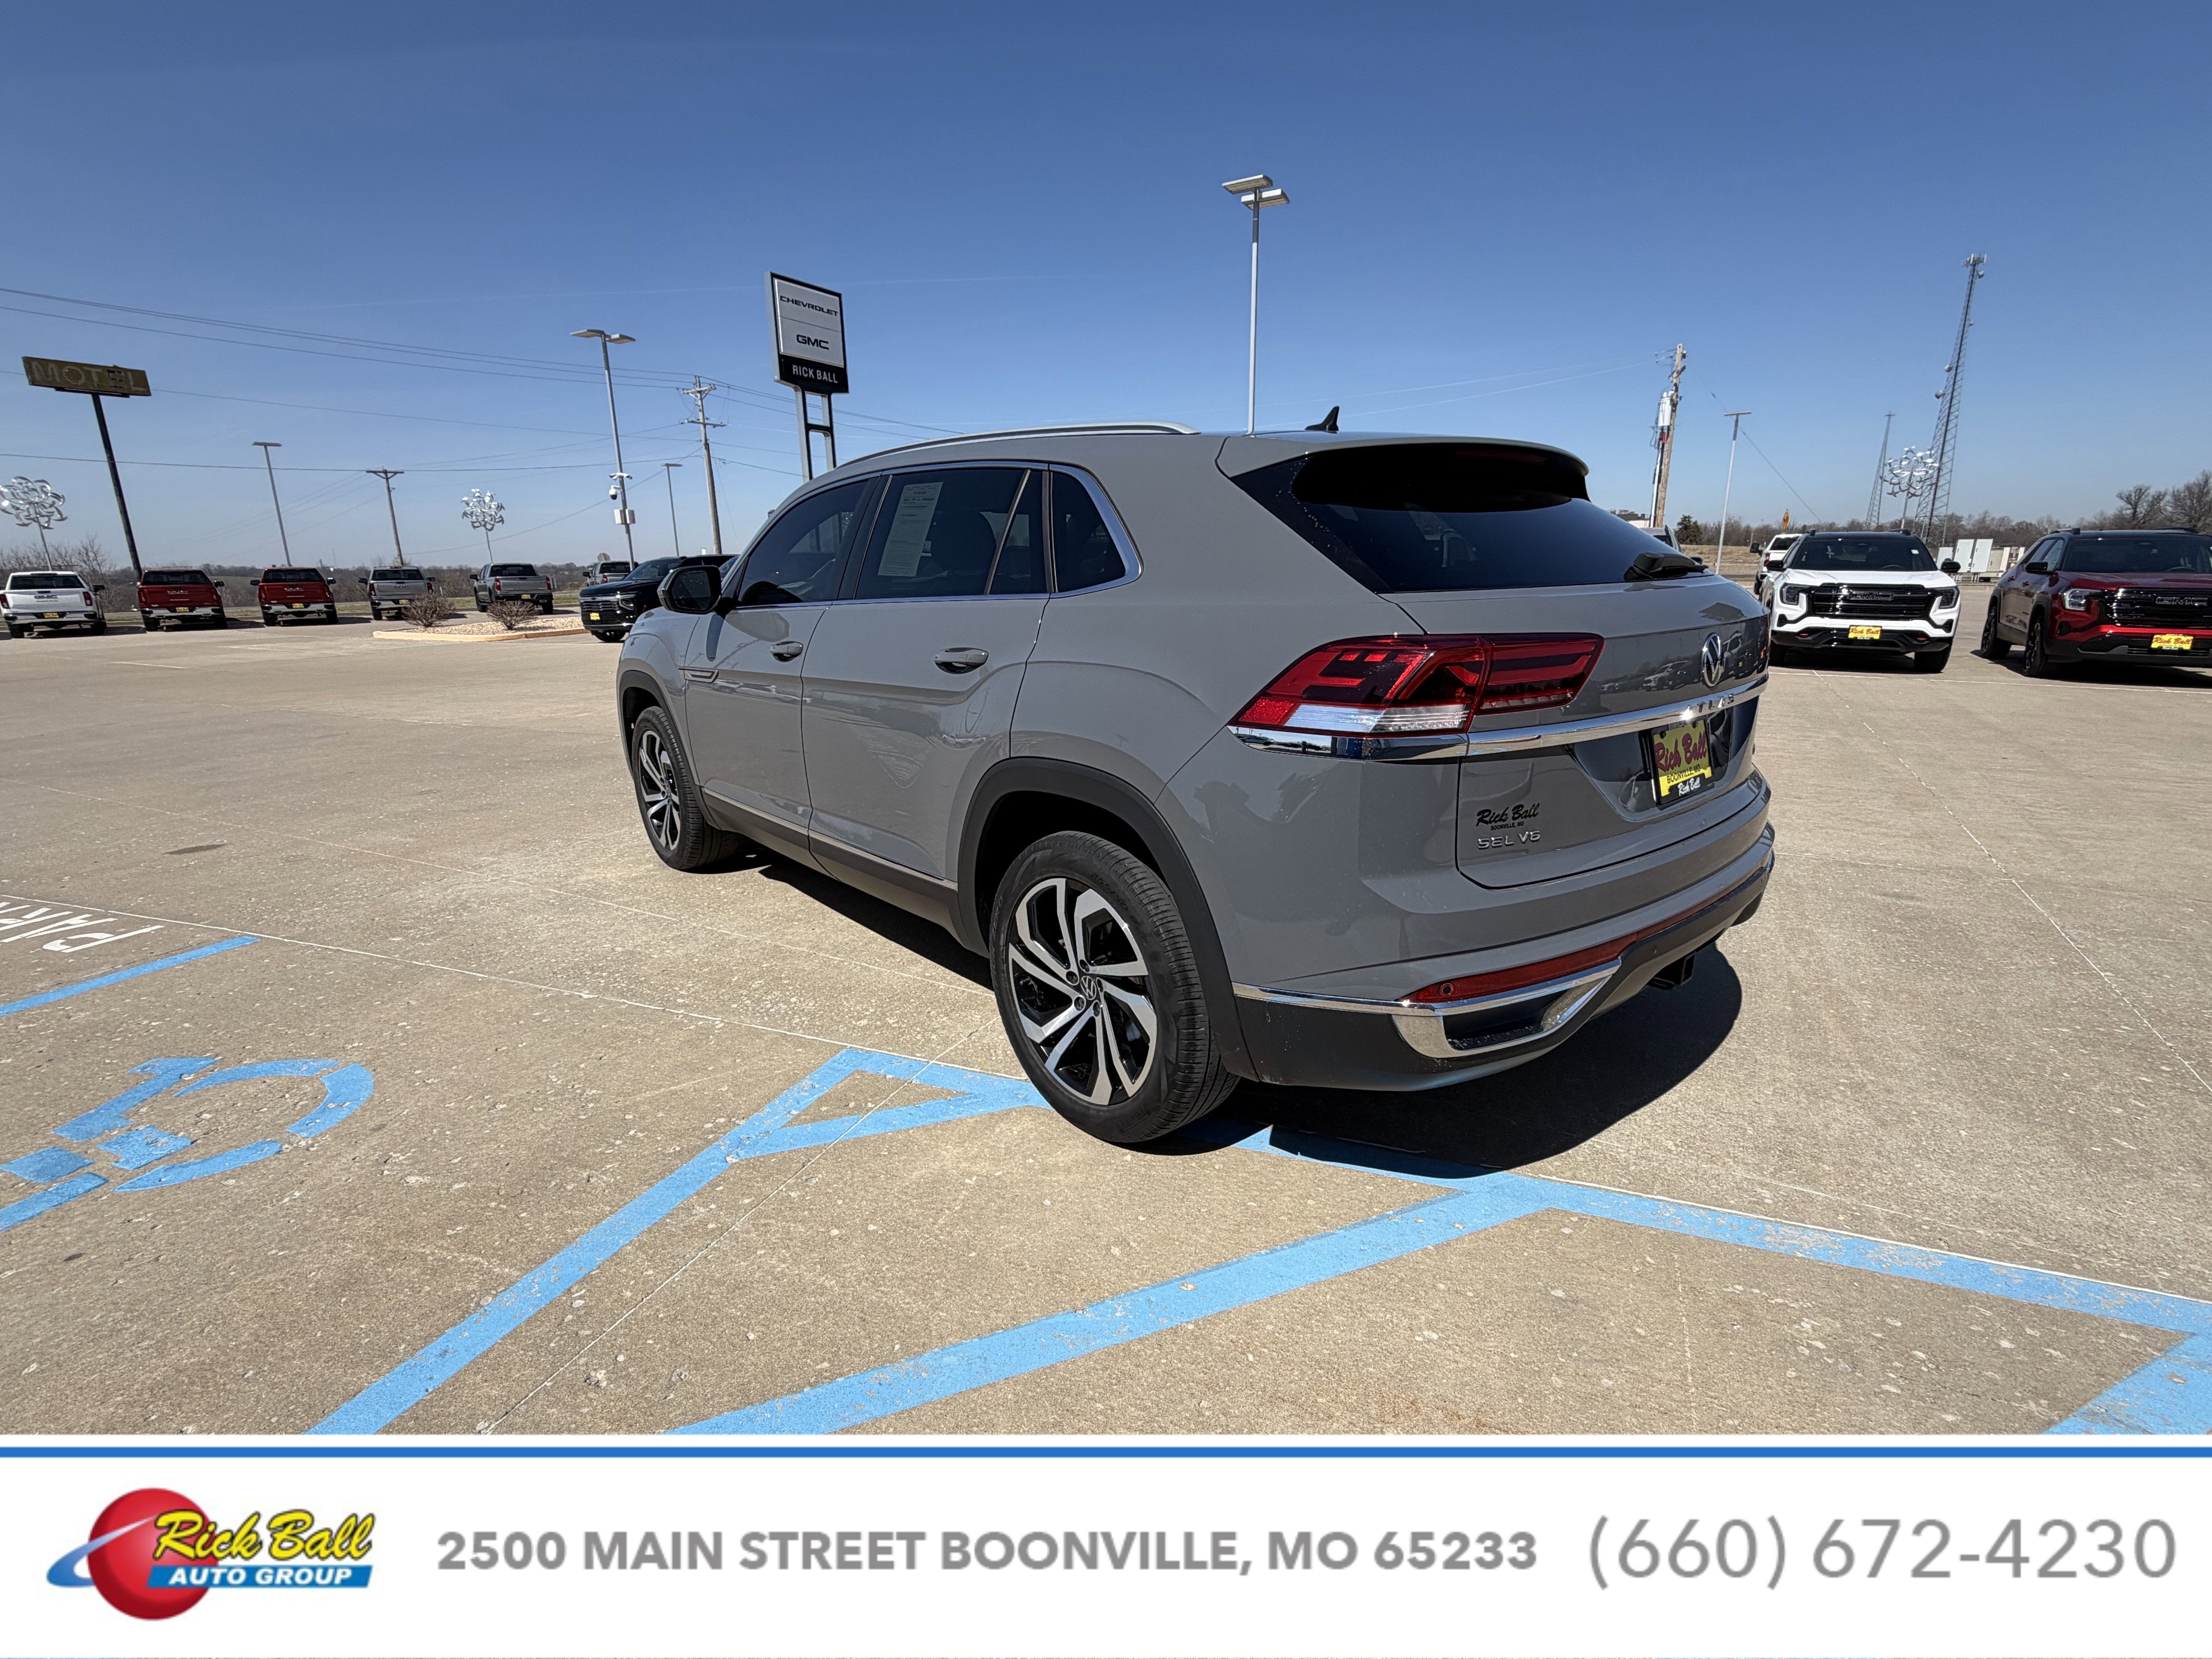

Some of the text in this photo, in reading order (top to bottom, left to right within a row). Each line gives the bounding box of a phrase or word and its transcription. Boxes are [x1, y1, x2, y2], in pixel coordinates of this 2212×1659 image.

[780, 295, 838, 316] CHEVROLET
[796, 334, 830, 350] GMC
[31, 361, 147, 392] MOTEL
[792, 365, 838, 383] RICK BALL
[1850, 591, 1893, 600] GMC
[2155, 597, 2208, 606] GMC
[1655, 731, 1707, 772] Rick Ball
[1476, 802, 1540, 826] Rick Ball
[1478, 831, 1540, 850] SEL V6
